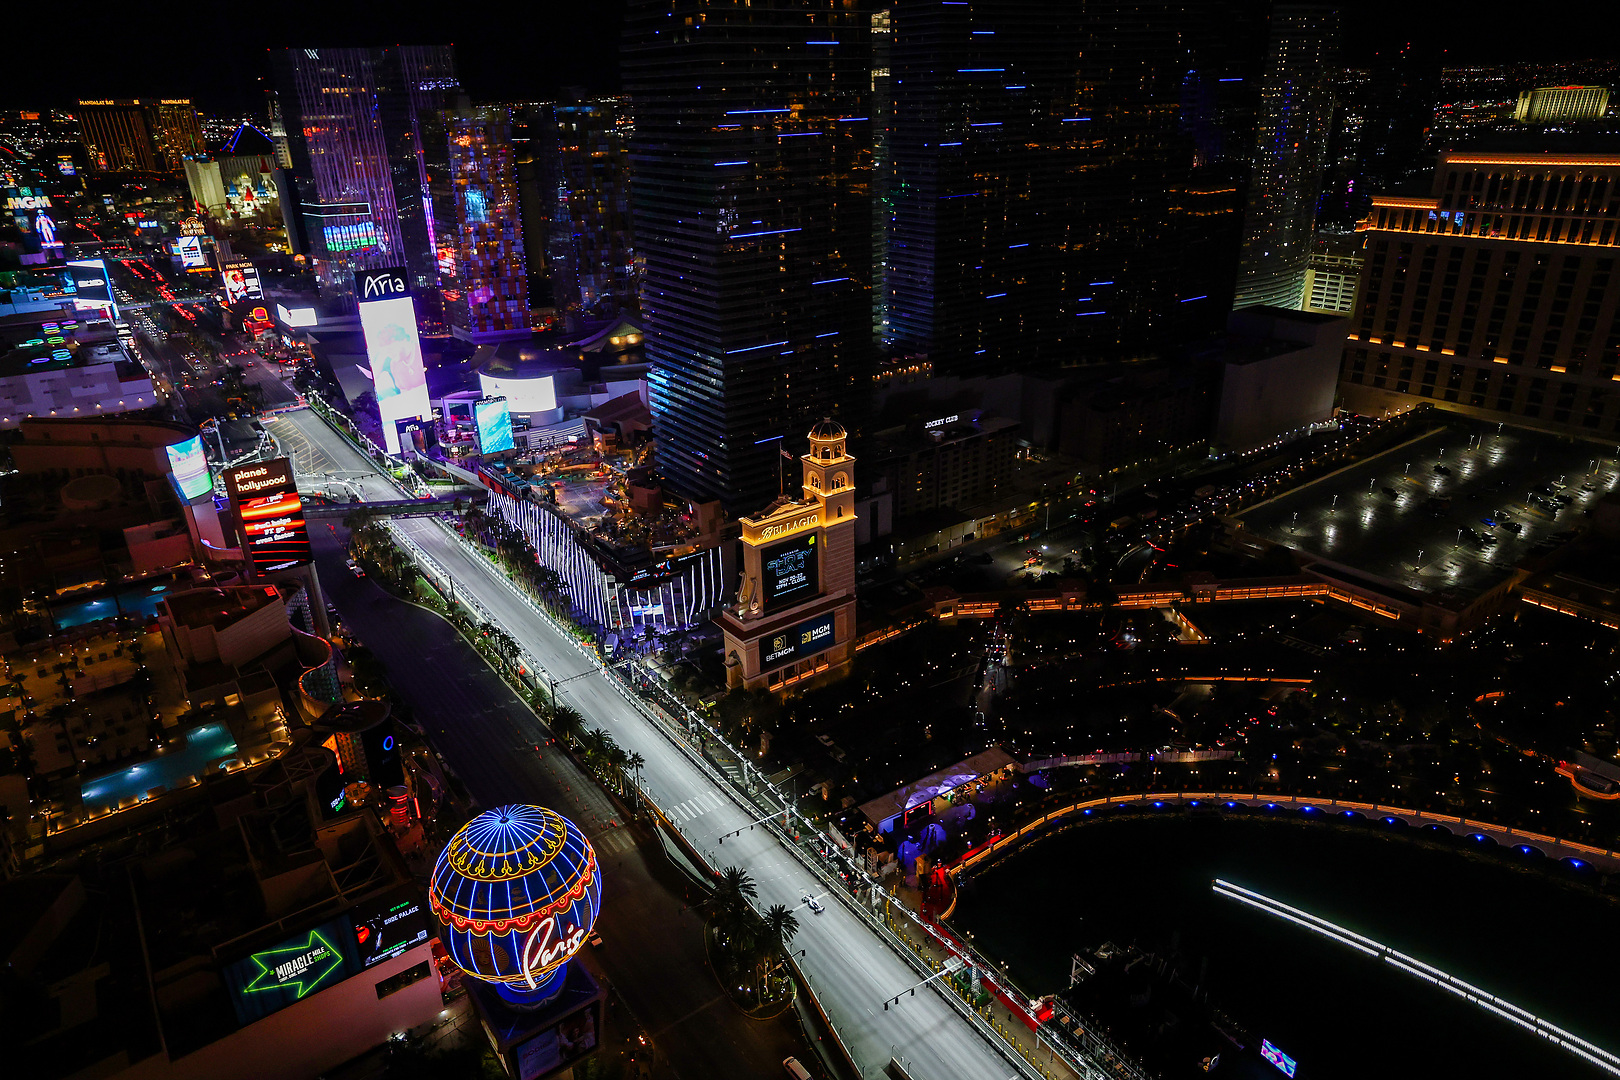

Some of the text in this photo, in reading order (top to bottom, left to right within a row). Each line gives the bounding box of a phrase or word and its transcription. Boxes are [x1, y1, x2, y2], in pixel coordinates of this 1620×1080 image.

[7, 196, 52, 209] MGM
[364, 273, 405, 298] Aria
[924, 414, 958, 428] JOCKEY CLUB
[234, 467, 268, 482] planet
[237, 474, 286, 492] hollywood
[758, 514, 818, 541] BELLAGIO
[778, 577, 789, 585] NOV
[791, 575, 807, 585] CLOSE
[812, 623, 830, 637] MGM
[765, 645, 795, 662] BETMGM
[398, 905, 420, 919] PALACE
[312, 946, 325, 957] MILE
[313, 950, 331, 962] SHOPS
[523, 917, 585, 990] Paris
[275, 952, 315, 979] MIRACLE
